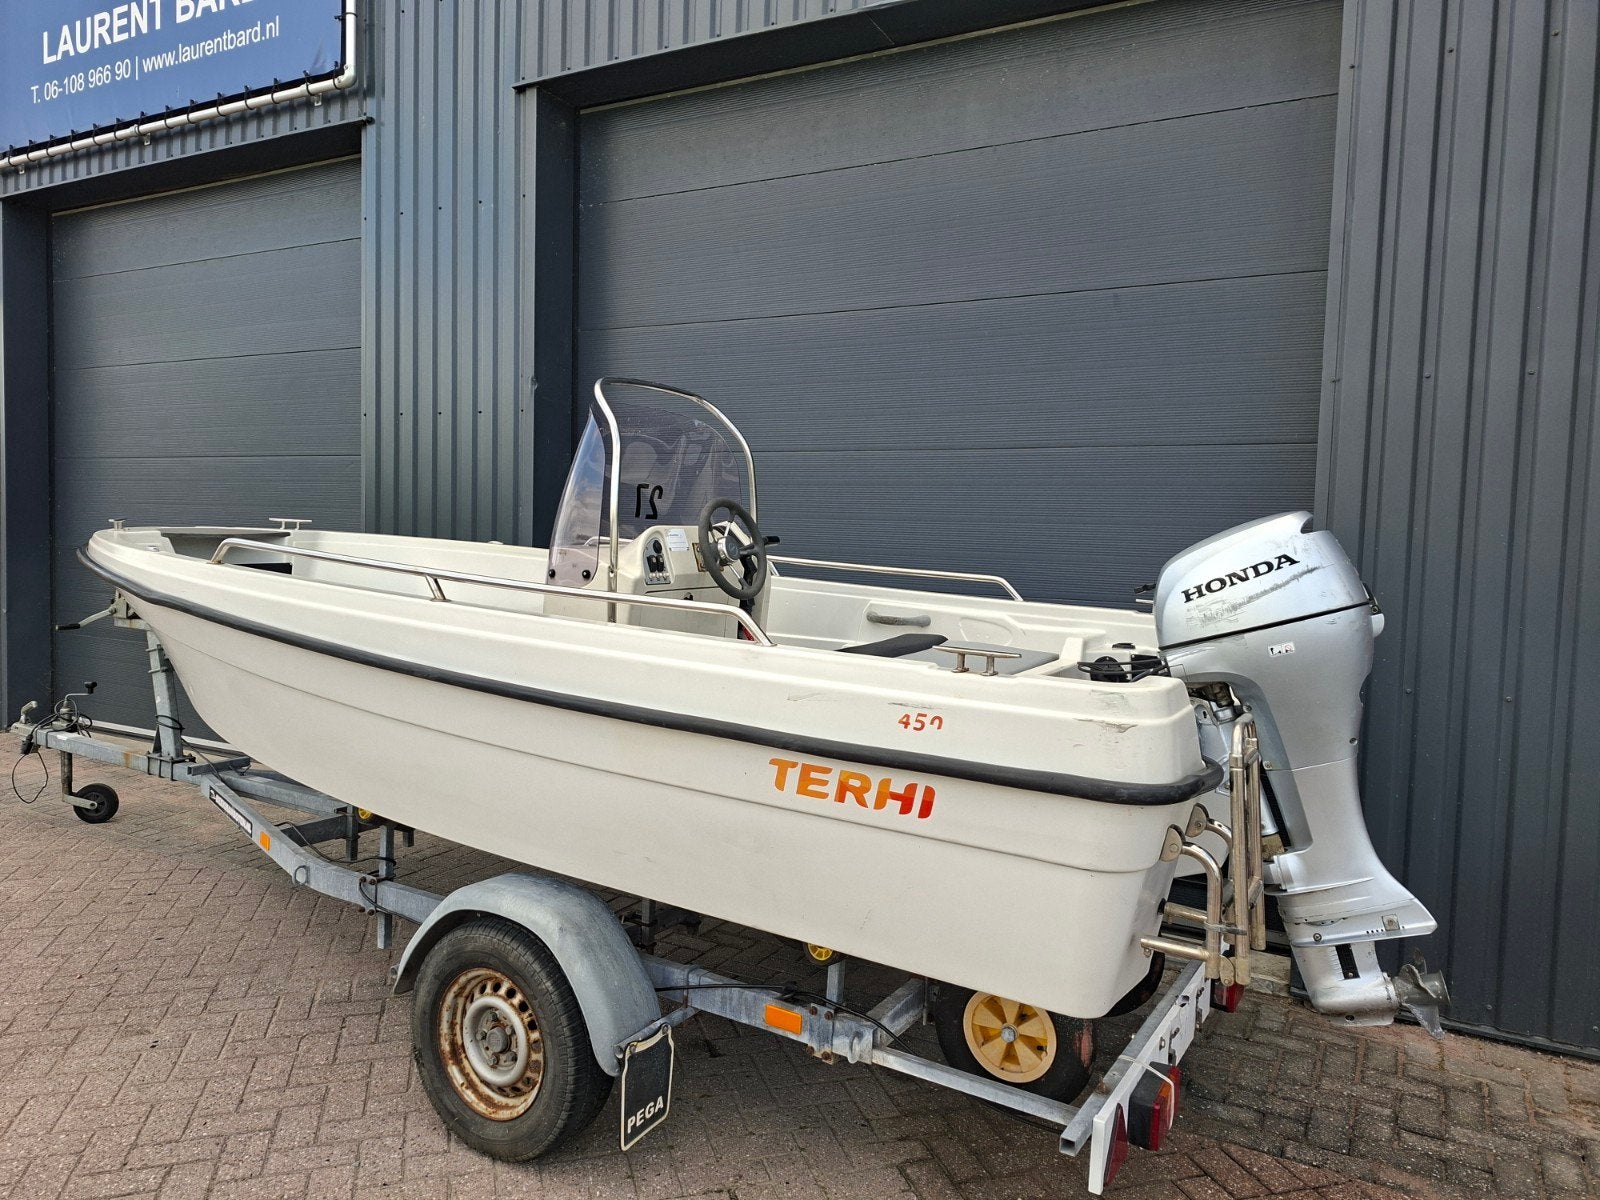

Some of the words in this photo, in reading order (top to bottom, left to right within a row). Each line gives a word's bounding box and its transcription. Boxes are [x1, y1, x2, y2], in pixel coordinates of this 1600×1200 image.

[30, 85, 41, 104] T.
[44, 73, 85, 101] 06-108
[88, 64, 112, 88] 966
[115, 58, 131, 81] 90
[142, 15, 279, 73] www.laurentbard.nl
[43, 0, 161, 65] LAURENT
[1181, 553, 1300, 604] HONDA
[768, 758, 936, 820] TERHI
[627, 1095, 664, 1134] PEGA
